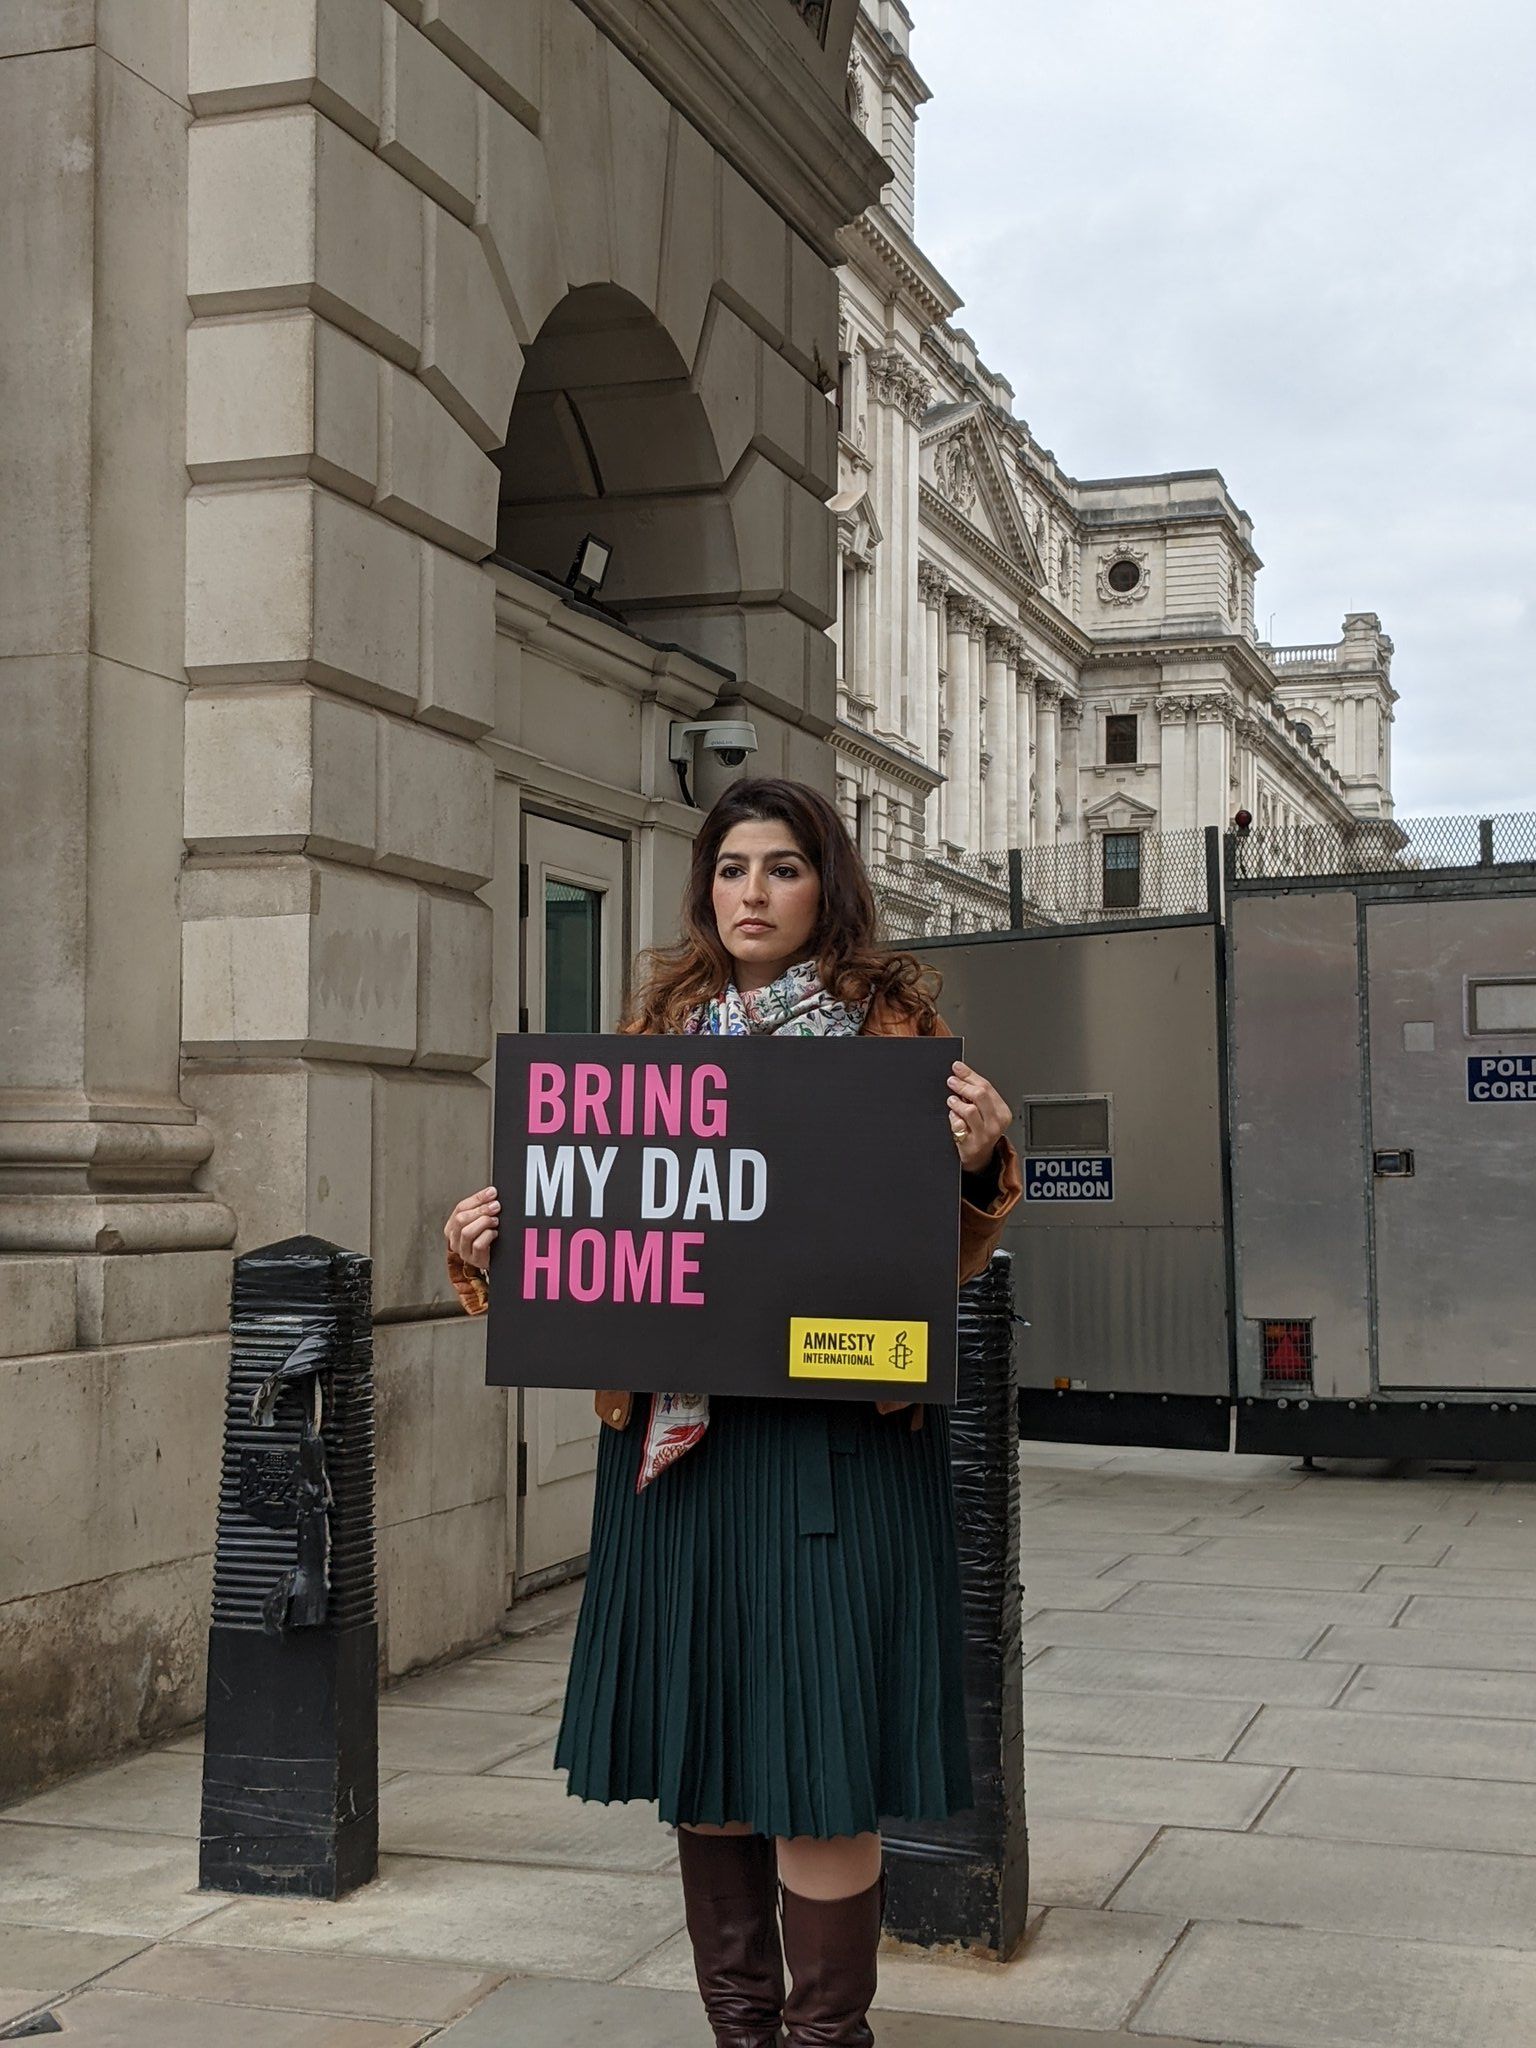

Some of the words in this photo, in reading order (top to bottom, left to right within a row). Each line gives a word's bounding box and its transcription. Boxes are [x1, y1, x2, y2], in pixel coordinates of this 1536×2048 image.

[527, 1062, 728, 1137] BRING
[1035, 1161, 1103, 1177] POLICE
[524, 1145, 619, 1218] MY
[641, 1147, 768, 1221] DAD
[1029, 1181, 1110, 1198] CORDON
[523, 1228, 705, 1305] HOME
[803, 1332, 876, 1352] AMNESTY
[803, 1353, 875, 1366] INTERNATIONAL
